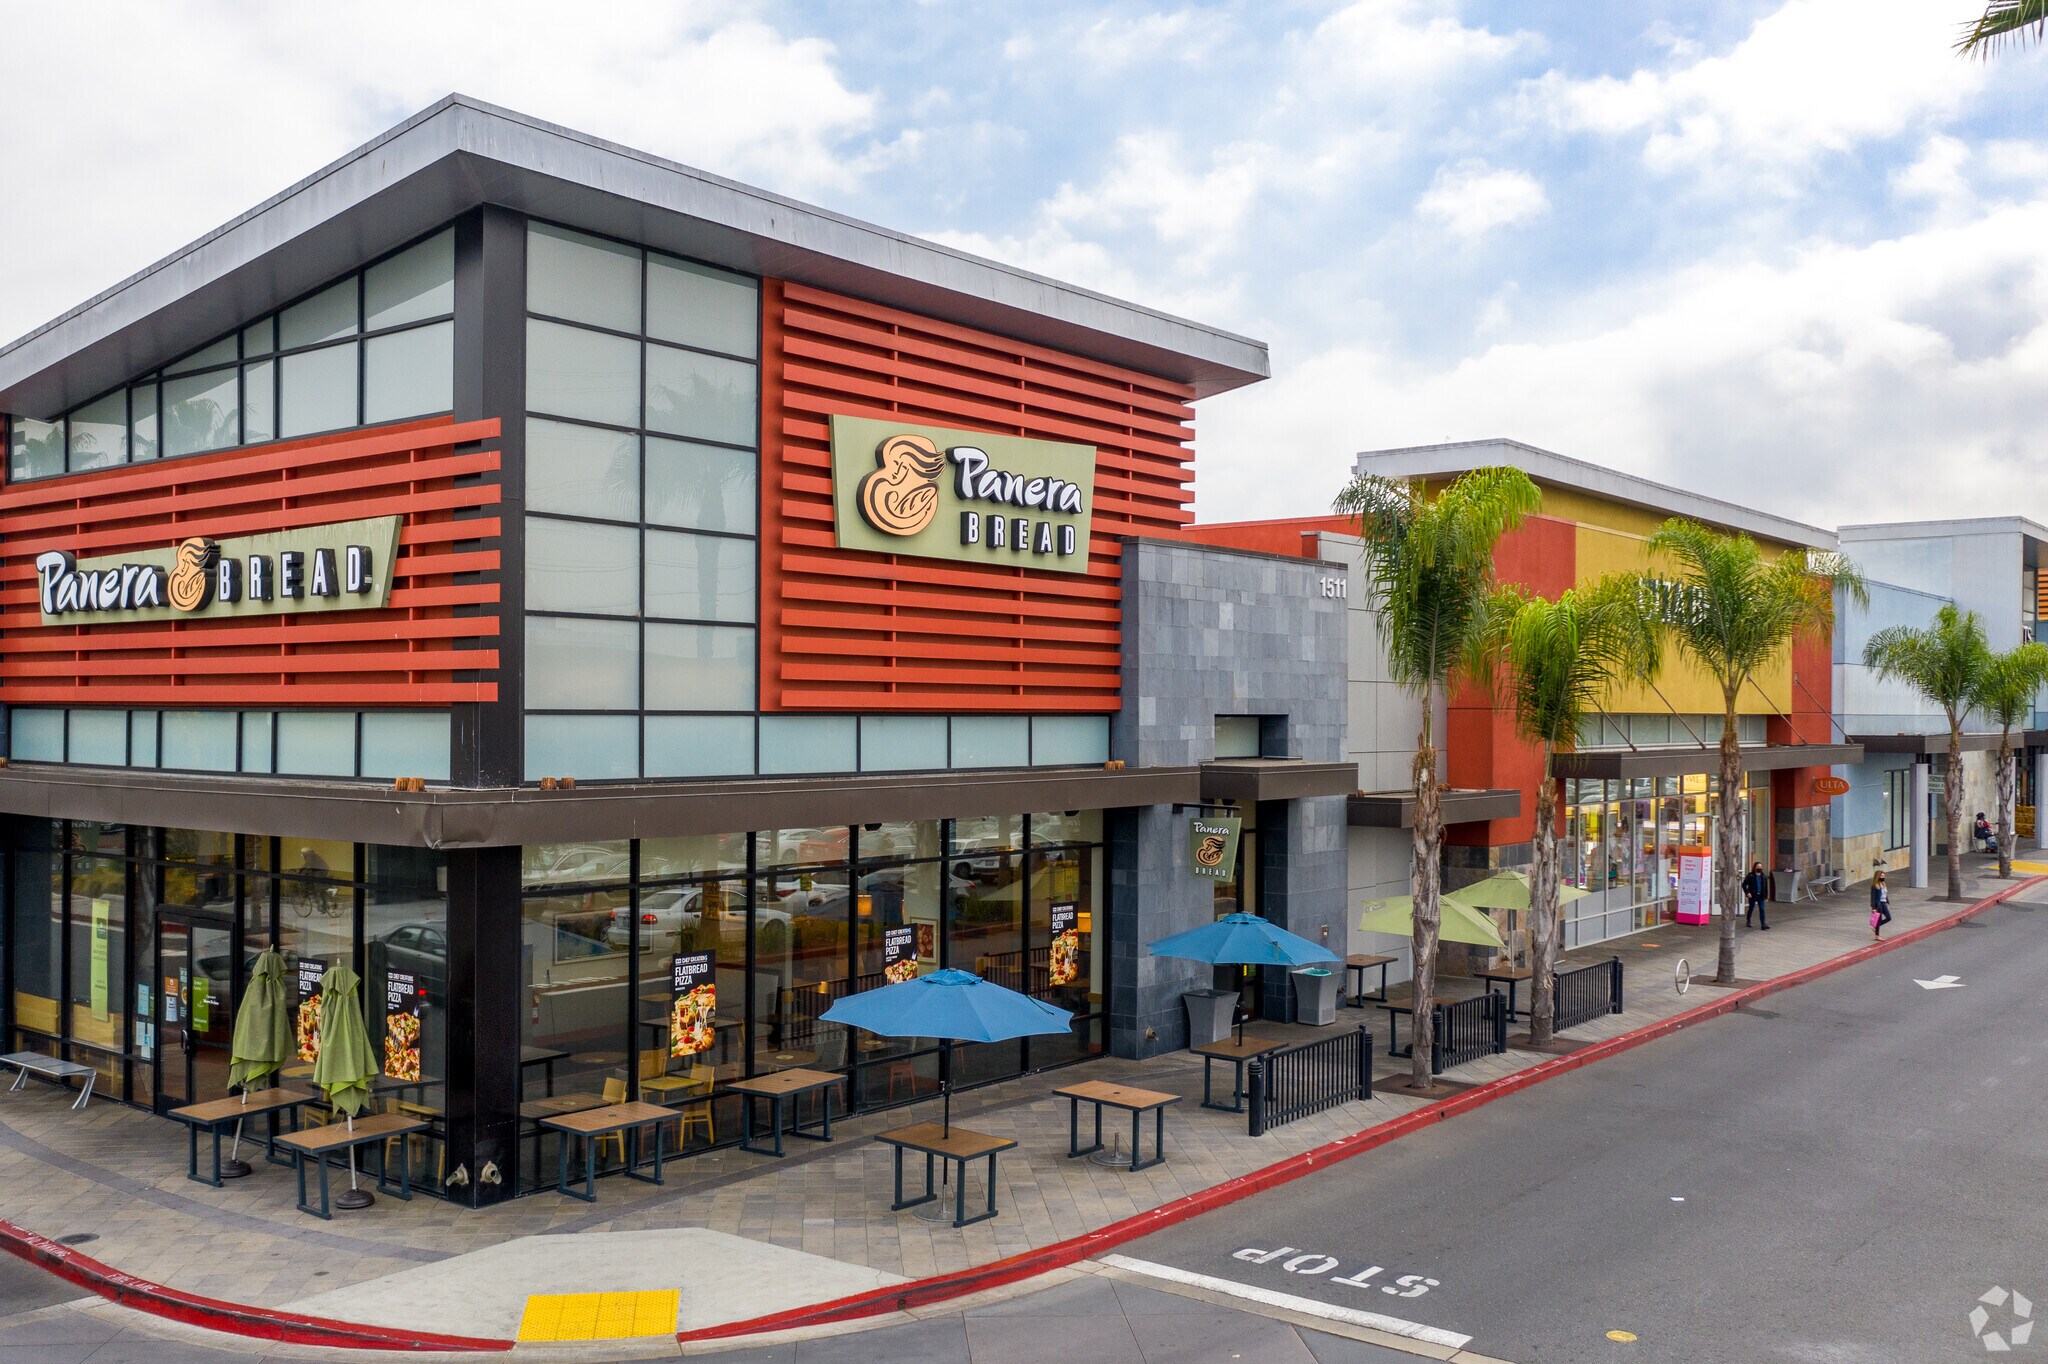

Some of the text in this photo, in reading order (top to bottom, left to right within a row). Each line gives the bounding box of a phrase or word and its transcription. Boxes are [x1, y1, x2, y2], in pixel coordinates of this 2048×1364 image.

[953, 446, 1083, 514] Panera
[966, 512, 1076, 556] BREAD
[36, 546, 364, 614] Panera BREAD
[1320, 576, 1347, 599] 1511
[1820, 780, 1845, 789] ULTA
[1193, 821, 1231, 835] Panera
[1195, 866, 1227, 877] BREAD
[885, 935, 912, 947] FLATBREAD
[885, 945, 900, 956] PIZZA
[675, 964, 708, 976] FLATBREAD
[299, 980, 312, 991] PIZZA
[675, 975, 692, 986] PIZZA
[387, 981, 414, 995] FLATBREAD
[387, 991, 402, 1003] PIZZA
[1232, 1246, 1441, 1298] STOP
